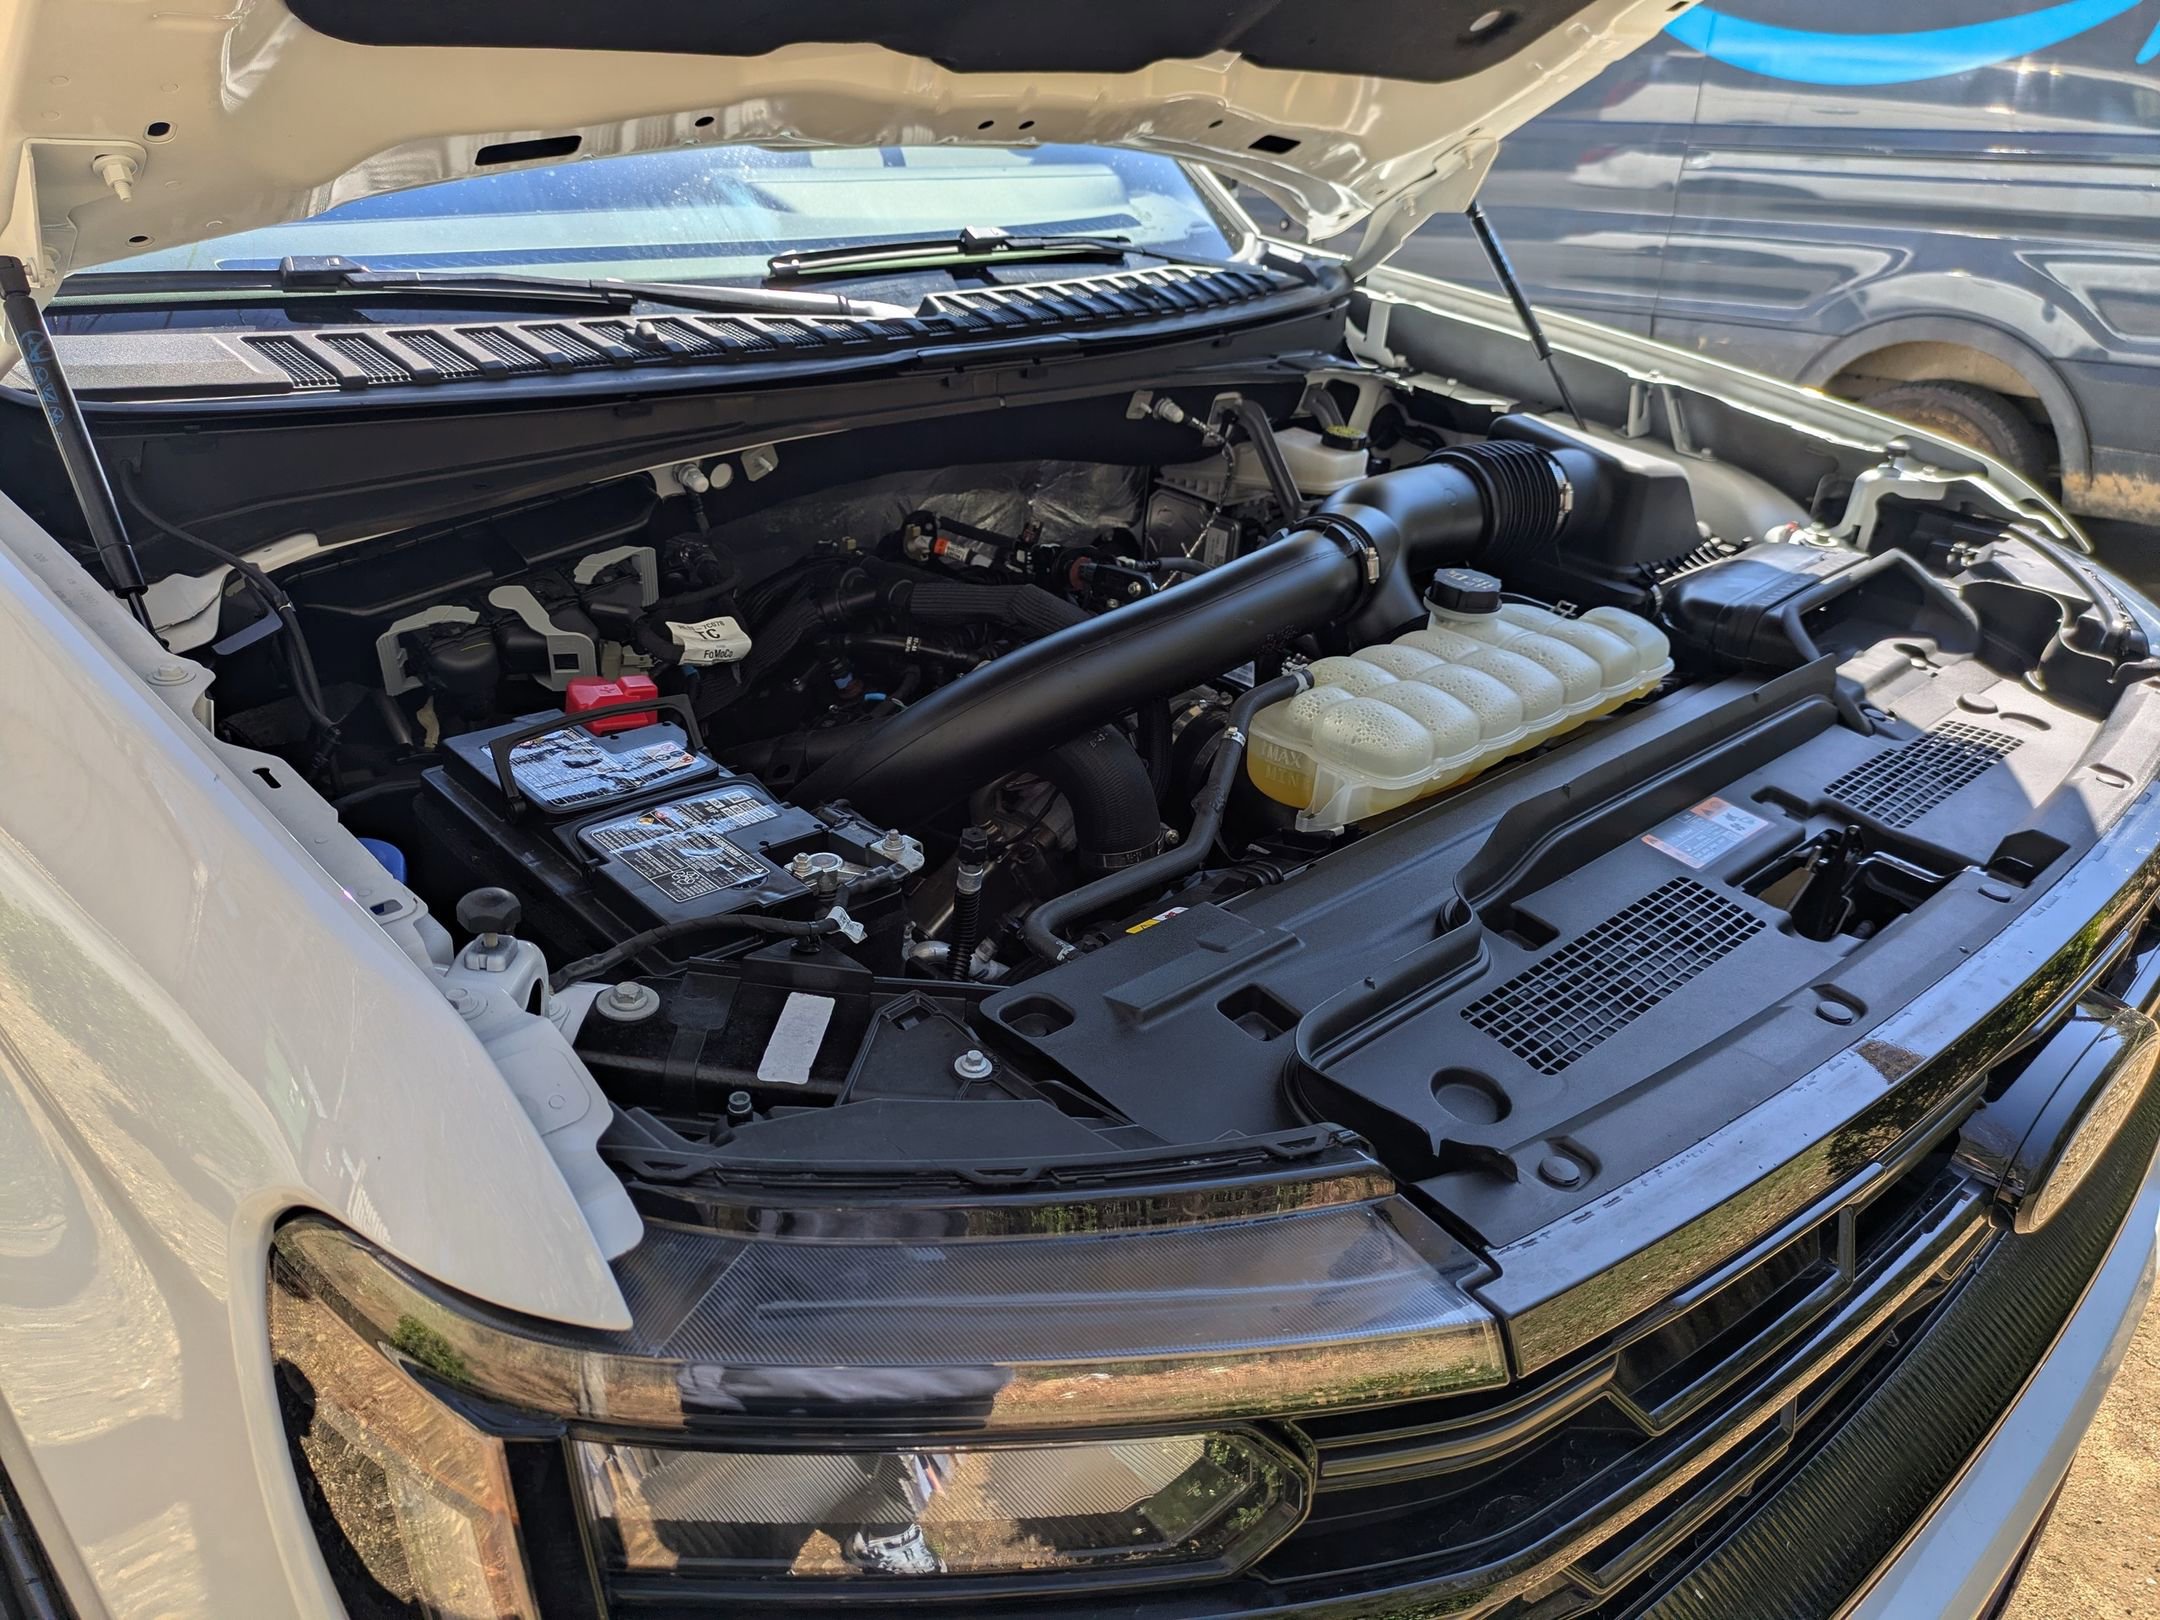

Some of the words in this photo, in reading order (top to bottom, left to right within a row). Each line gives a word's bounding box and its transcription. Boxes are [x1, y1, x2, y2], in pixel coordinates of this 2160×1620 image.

[703, 649, 734, 659] FoMoCo
[1265, 743, 1302, 769] MAX
[1265, 763, 1300, 787] MIN
